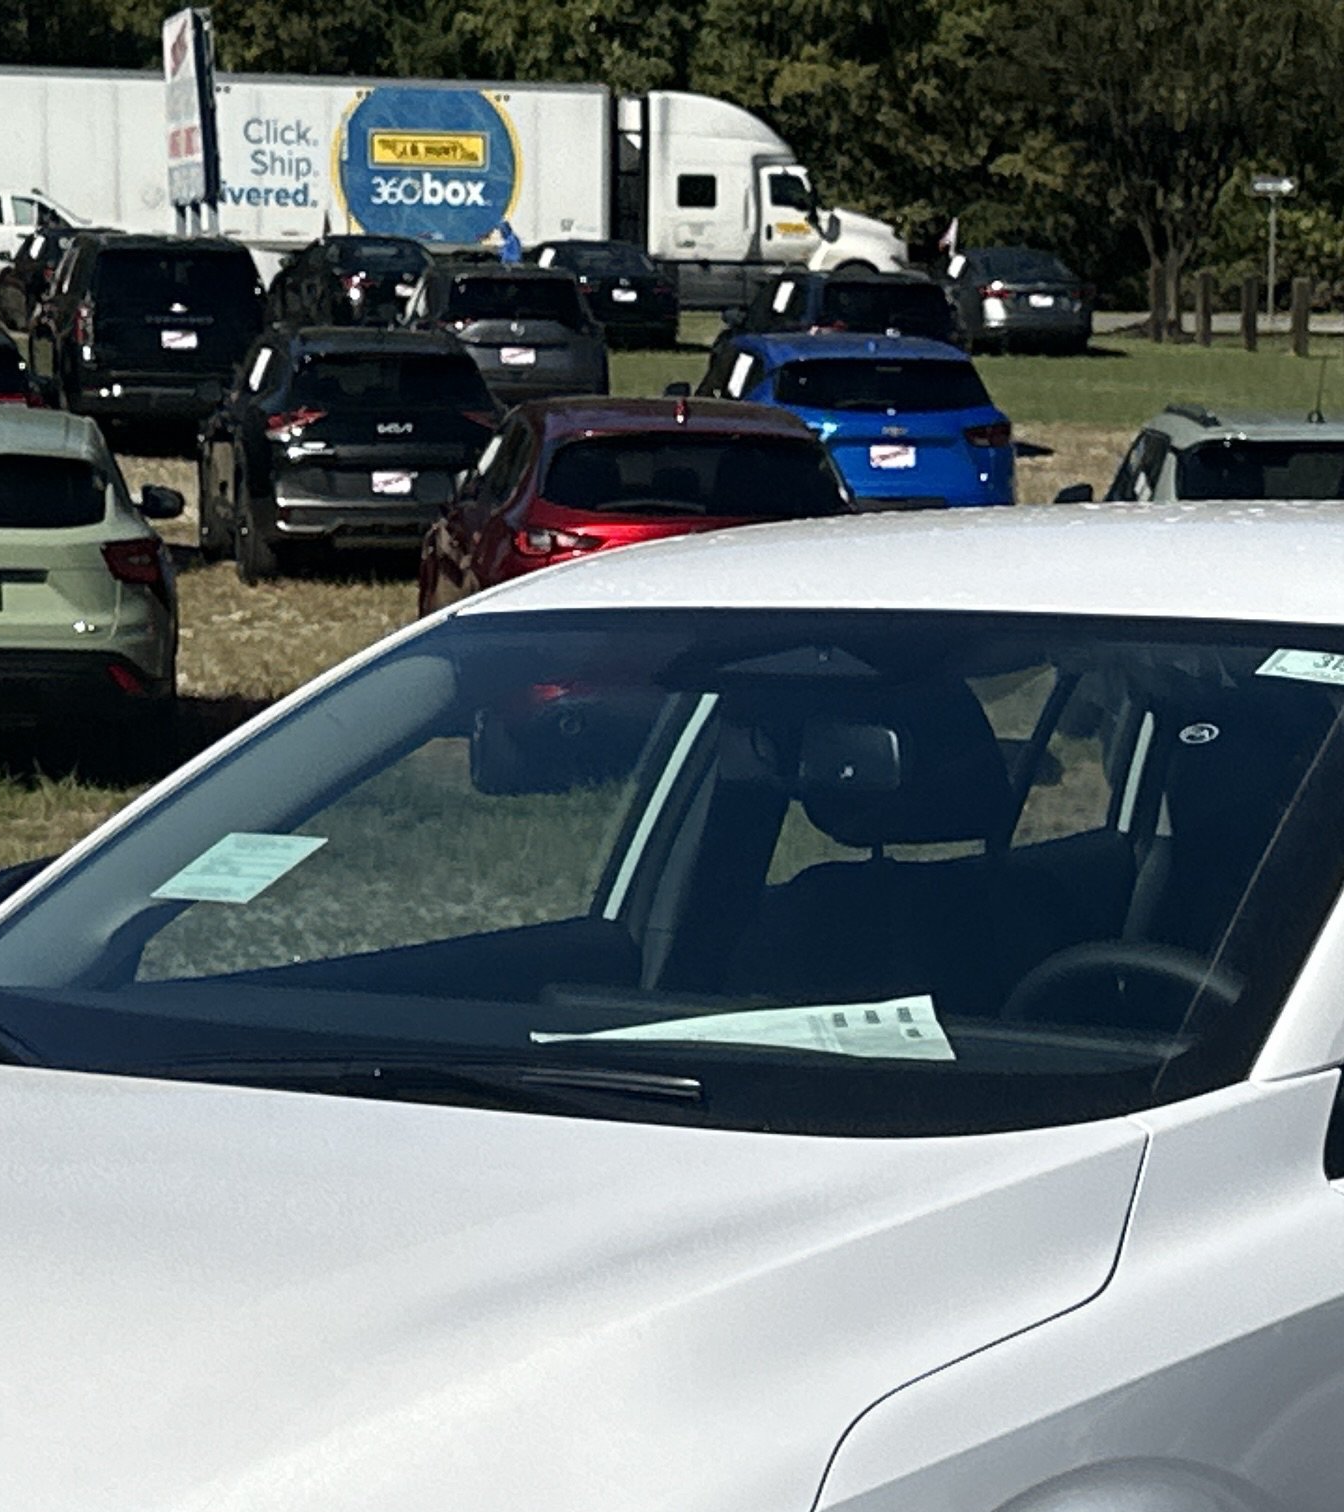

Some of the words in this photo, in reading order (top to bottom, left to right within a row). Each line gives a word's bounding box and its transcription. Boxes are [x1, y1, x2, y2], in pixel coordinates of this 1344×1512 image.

[243, 118, 319, 146] Click.
[250, 149, 319, 182] Ship.
[219, 181, 318, 207] ivered.
[370, 172, 485, 206] 360box
